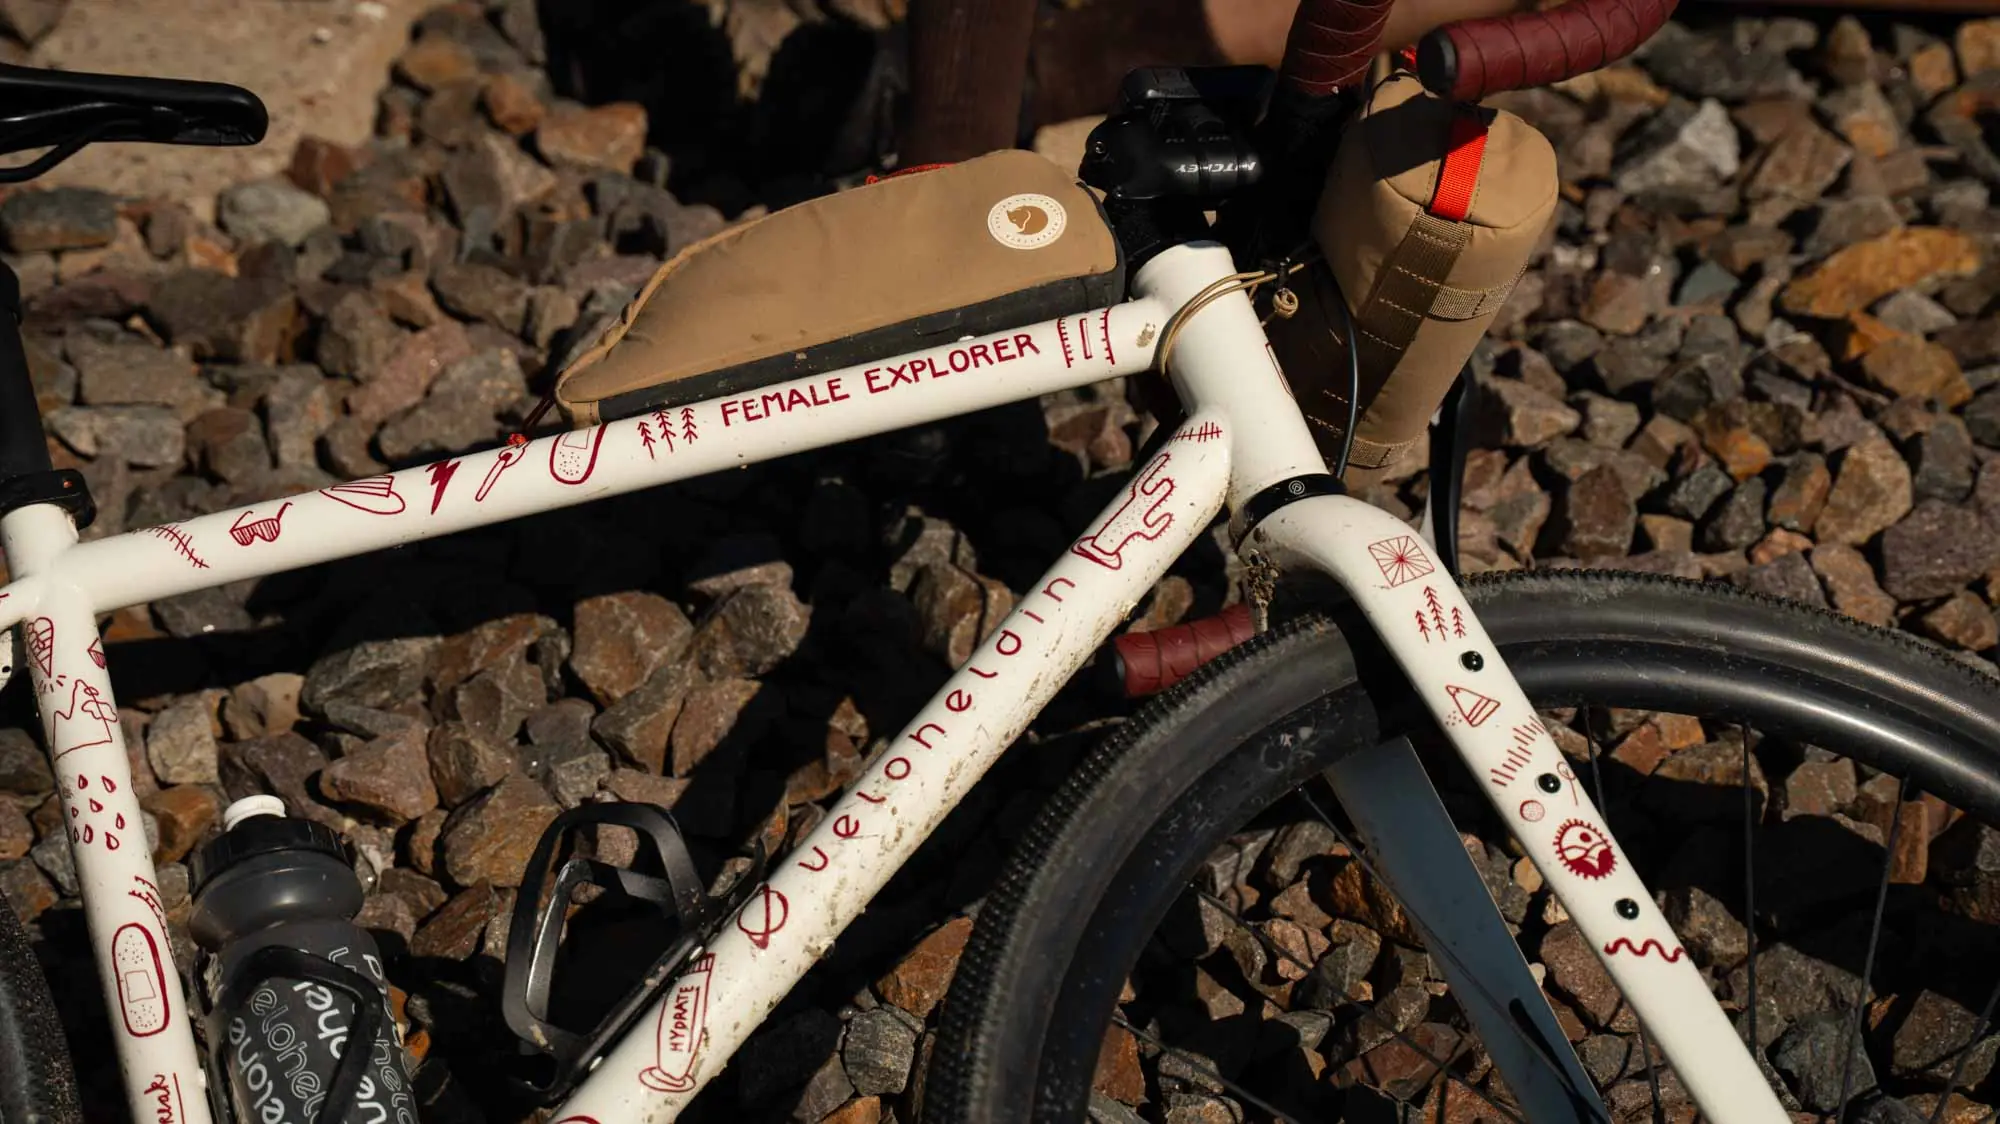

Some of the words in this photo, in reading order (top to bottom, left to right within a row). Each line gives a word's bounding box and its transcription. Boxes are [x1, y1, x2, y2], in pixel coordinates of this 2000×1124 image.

[720, 377, 850, 427] FEMALE
[864, 333, 1041, 394] EXPLORER
[669, 985, 694, 1052] HYDRATE
